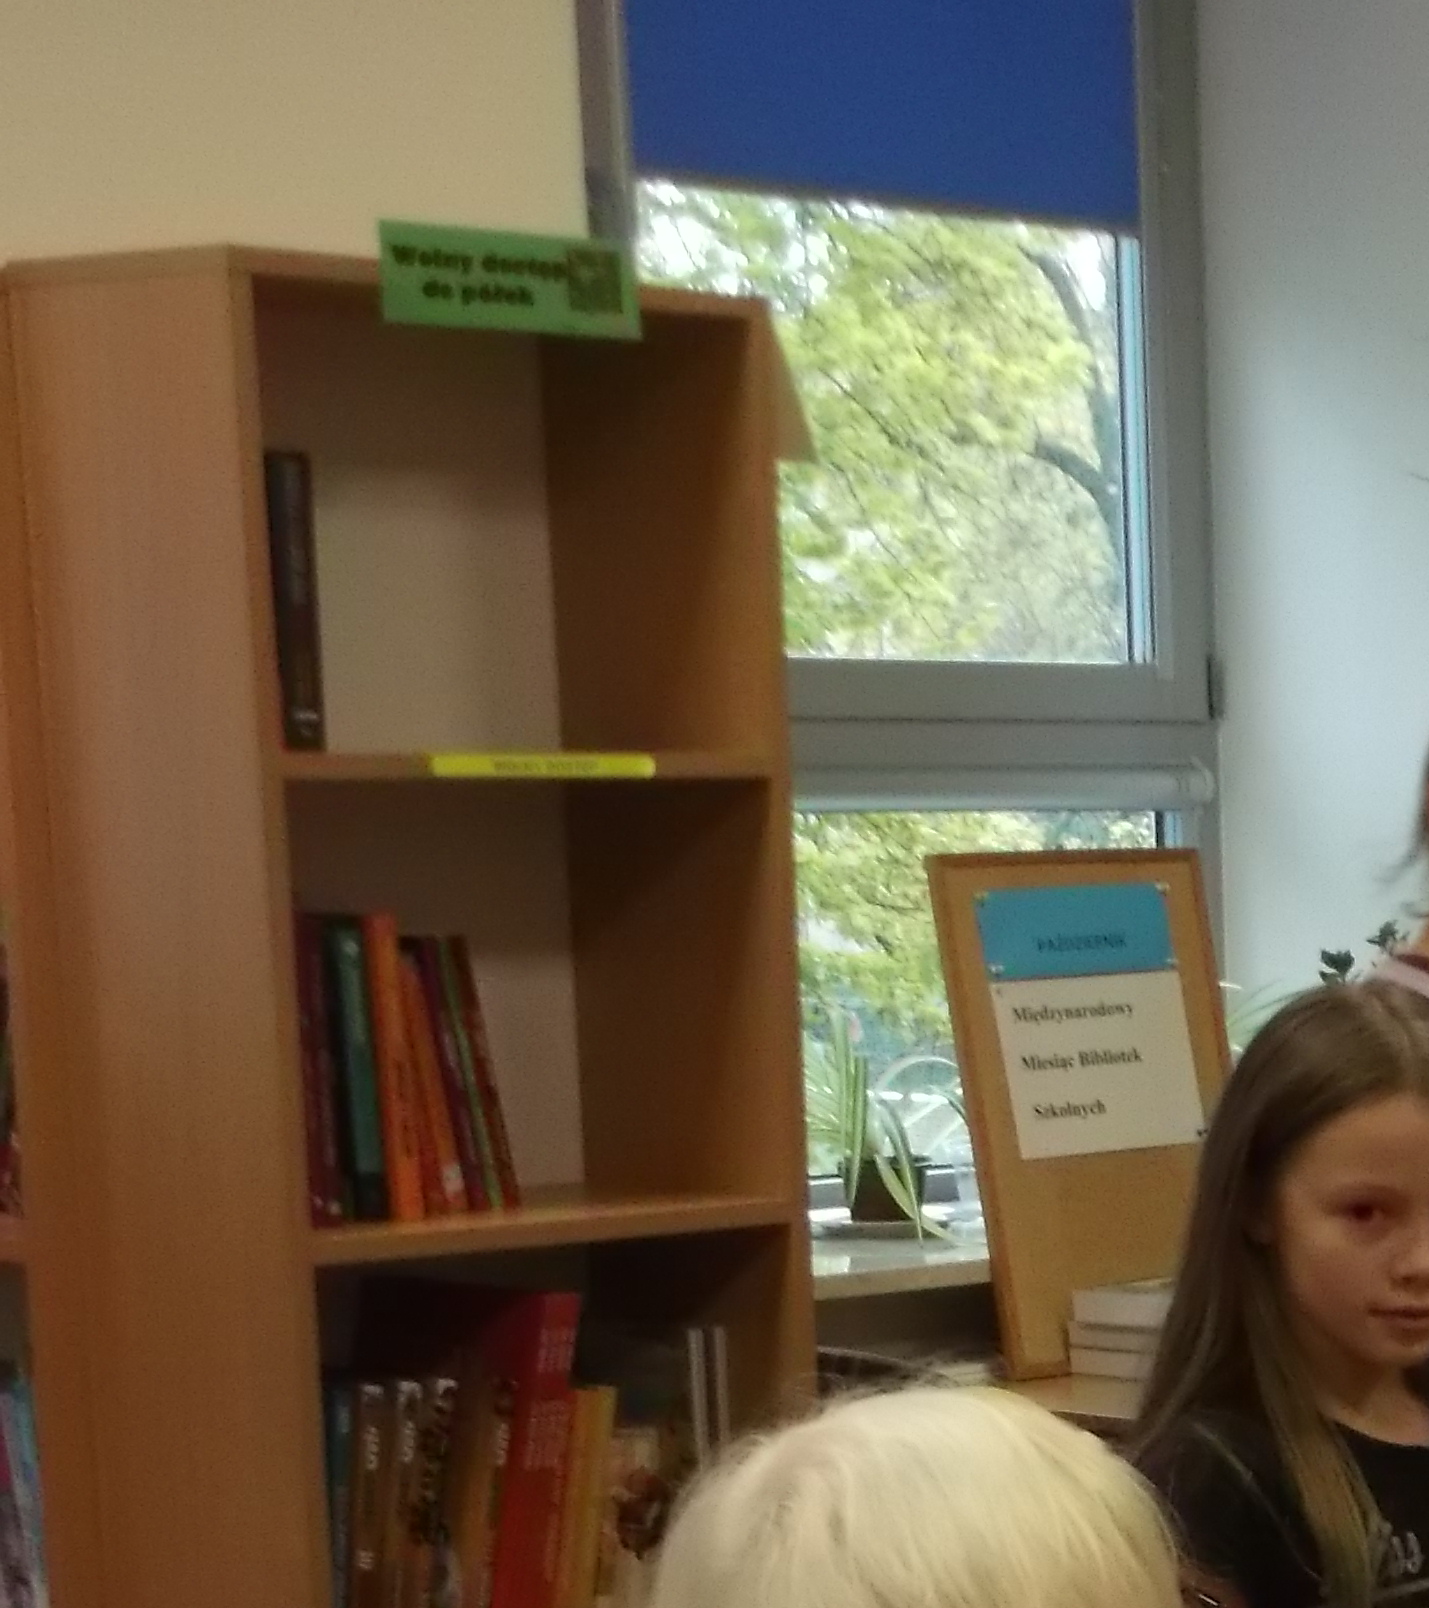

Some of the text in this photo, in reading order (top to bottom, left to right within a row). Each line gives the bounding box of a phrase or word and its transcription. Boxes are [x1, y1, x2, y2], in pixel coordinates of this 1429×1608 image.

[1012, 1002, 1133, 1025] Międzynarodowy
[1021, 1047, 1142, 1072] Miesiąc Bibliotek
[1033, 1098, 1107, 1120] Szkolnych
